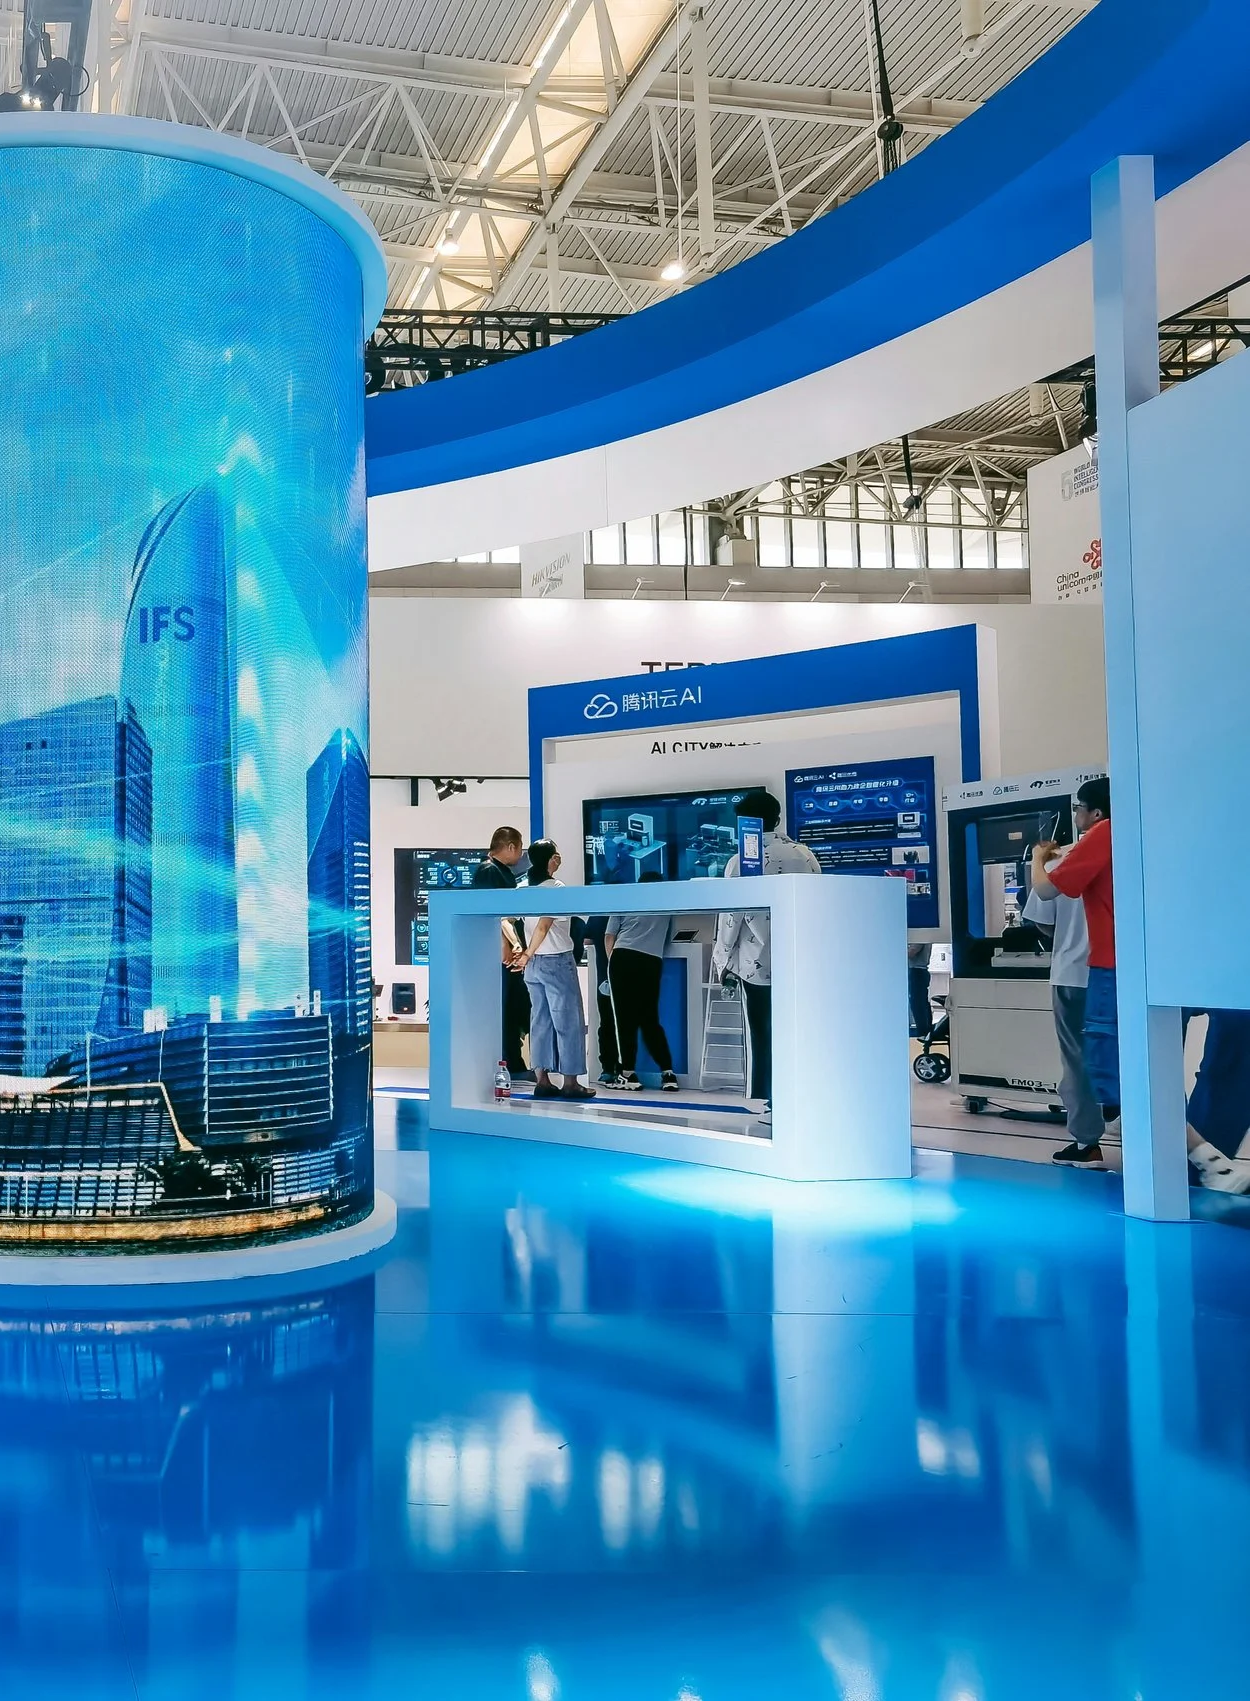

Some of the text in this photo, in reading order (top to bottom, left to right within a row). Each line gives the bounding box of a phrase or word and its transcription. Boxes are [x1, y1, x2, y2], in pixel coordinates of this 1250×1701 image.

[1056, 571, 1079, 584] China
[1057, 577, 1086, 592] unicom
[139, 606, 195, 643] IFS
[622, 686, 702, 713] 腾讯云AI
[651, 741, 666, 754] AI
